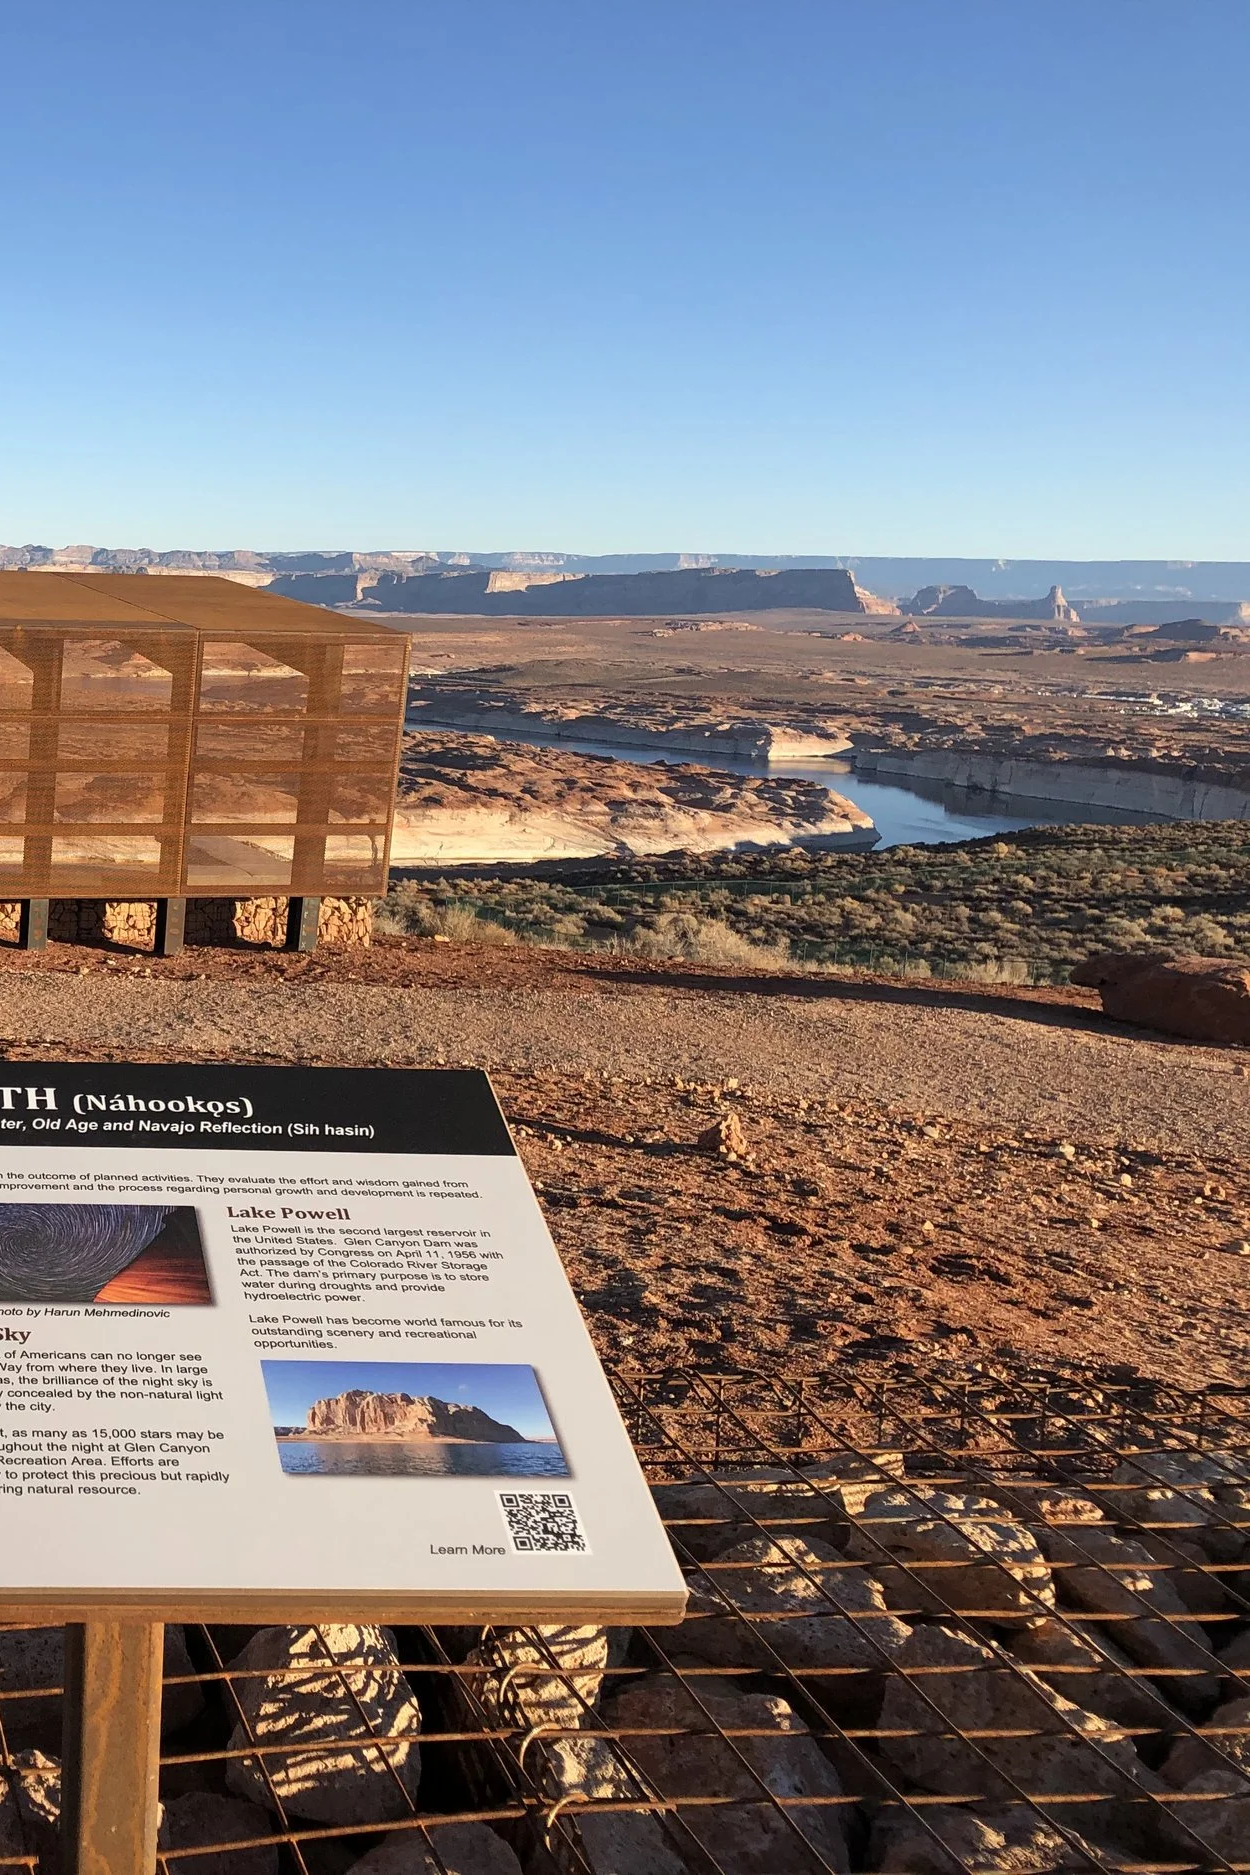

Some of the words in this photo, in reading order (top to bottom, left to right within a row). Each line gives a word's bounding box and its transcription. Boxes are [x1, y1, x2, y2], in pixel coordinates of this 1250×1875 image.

[31, 1117, 61, 1130] Old
[64, 1118, 99, 1133] Age
[102, 1119, 134, 1131] and
[138, 1119, 195, 1135] Navajo
[199, 1120, 282, 1134] Reflection
[287, 1122, 320, 1137] (Sih
[324, 1123, 375, 1139] hasin)
[72, 1183, 94, 1191] and
[96, 1182, 115, 1191] the
[118, 1184, 163, 1192] process
[166, 1184, 220, 1194] regarding
[222, 1186, 272, 1195] personal
[274, 1187, 313, 1196] growth
[316, 1187, 338, 1195] and
[340, 1188, 414, 1198] development
[415, 1189, 426, 1197] is
[428, 1190, 483, 1199] repeated.
[226, 1206, 276, 1219] Lake
[280, 1207, 351, 1220] Powell
[230, 1224, 259, 1233] Lake
[261, 1224, 301, 1234] Powell
[303, 1225, 314, 1234] is
[316, 1226, 336, 1235] the
[338, 1227, 381, 1236] second
[383, 1227, 424, 1237] largest
[425, 1229, 477, 1237] reservoir
[235, 1246, 297, 1255] authorized
[299, 1246, 314, 1258] by
[317, 1247, 375, 1258] Congress
[395, 1249, 423, 1259] April
[425, 1249, 444, 1259] 11,
[447, 1250, 477, 1259] 1956
[478, 1251, 504, 1259] with
[243, 1291, 322, 1302] hydroelectric
[324, 1294, 366, 1303] power.
[26, 1307, 41, 1318] by
[43, 1307, 81, 1317] Harun
[83, 1307, 170, 1318] Mehmedinovic
[248, 1314, 279, 1324] Lake
[281, 1314, 323, 1324] Powell
[325, 1315, 349, 1325] has
[351, 1316, 401, 1326] become
[403, 1317, 438, 1327] world
[440, 1317, 486, 1327] famous
[488, 1318, 505, 1327] for
[508, 1319, 523, 1328] its
[251, 1327, 323, 1338] outstanding
[326, 1329, 374, 1339] scenery
[378, 1329, 402, 1338] and
[404, 1330, 477, 1339] recreational
[253, 1339, 339, 1349] opportunities.
[3, 1349, 16, 1359] of
[19, 1349, 87, 1360] Americans
[90, 1352, 113, 1360] can
[116, 1352, 133, 1361] no
[135, 1351, 176, 1363] longer
[178, 1353, 202, 1361] see
[6, 1388, 73, 1398] concealed
[76, 1388, 92, 1400] by
[95, 1389, 116, 1399] the
[119, 1389, 193, 1399] non-natural
[195, 1390, 223, 1402] light
[5, 1401, 26, 1411] the
[29, 1401, 56, 1413] city.
[11, 1429, 28, 1438] as
[31, 1429, 68, 1440] many
[71, 1430, 87, 1438] as
[92, 1428, 136, 1439] 15,000
[140, 1429, 172, 1439] stars
[176, 1431, 204, 1442] may
[207, 1429, 224, 1440] be
[70, 1455, 106, 1466] Area.
[110, 1455, 154, 1466] Efforts
[157, 1458, 179, 1467] are
[27, 1483, 74, 1494] natural
[77, 1486, 141, 1495] resource.
[429, 1544, 468, 1555] Learn
[472, 1544, 506, 1555] More
